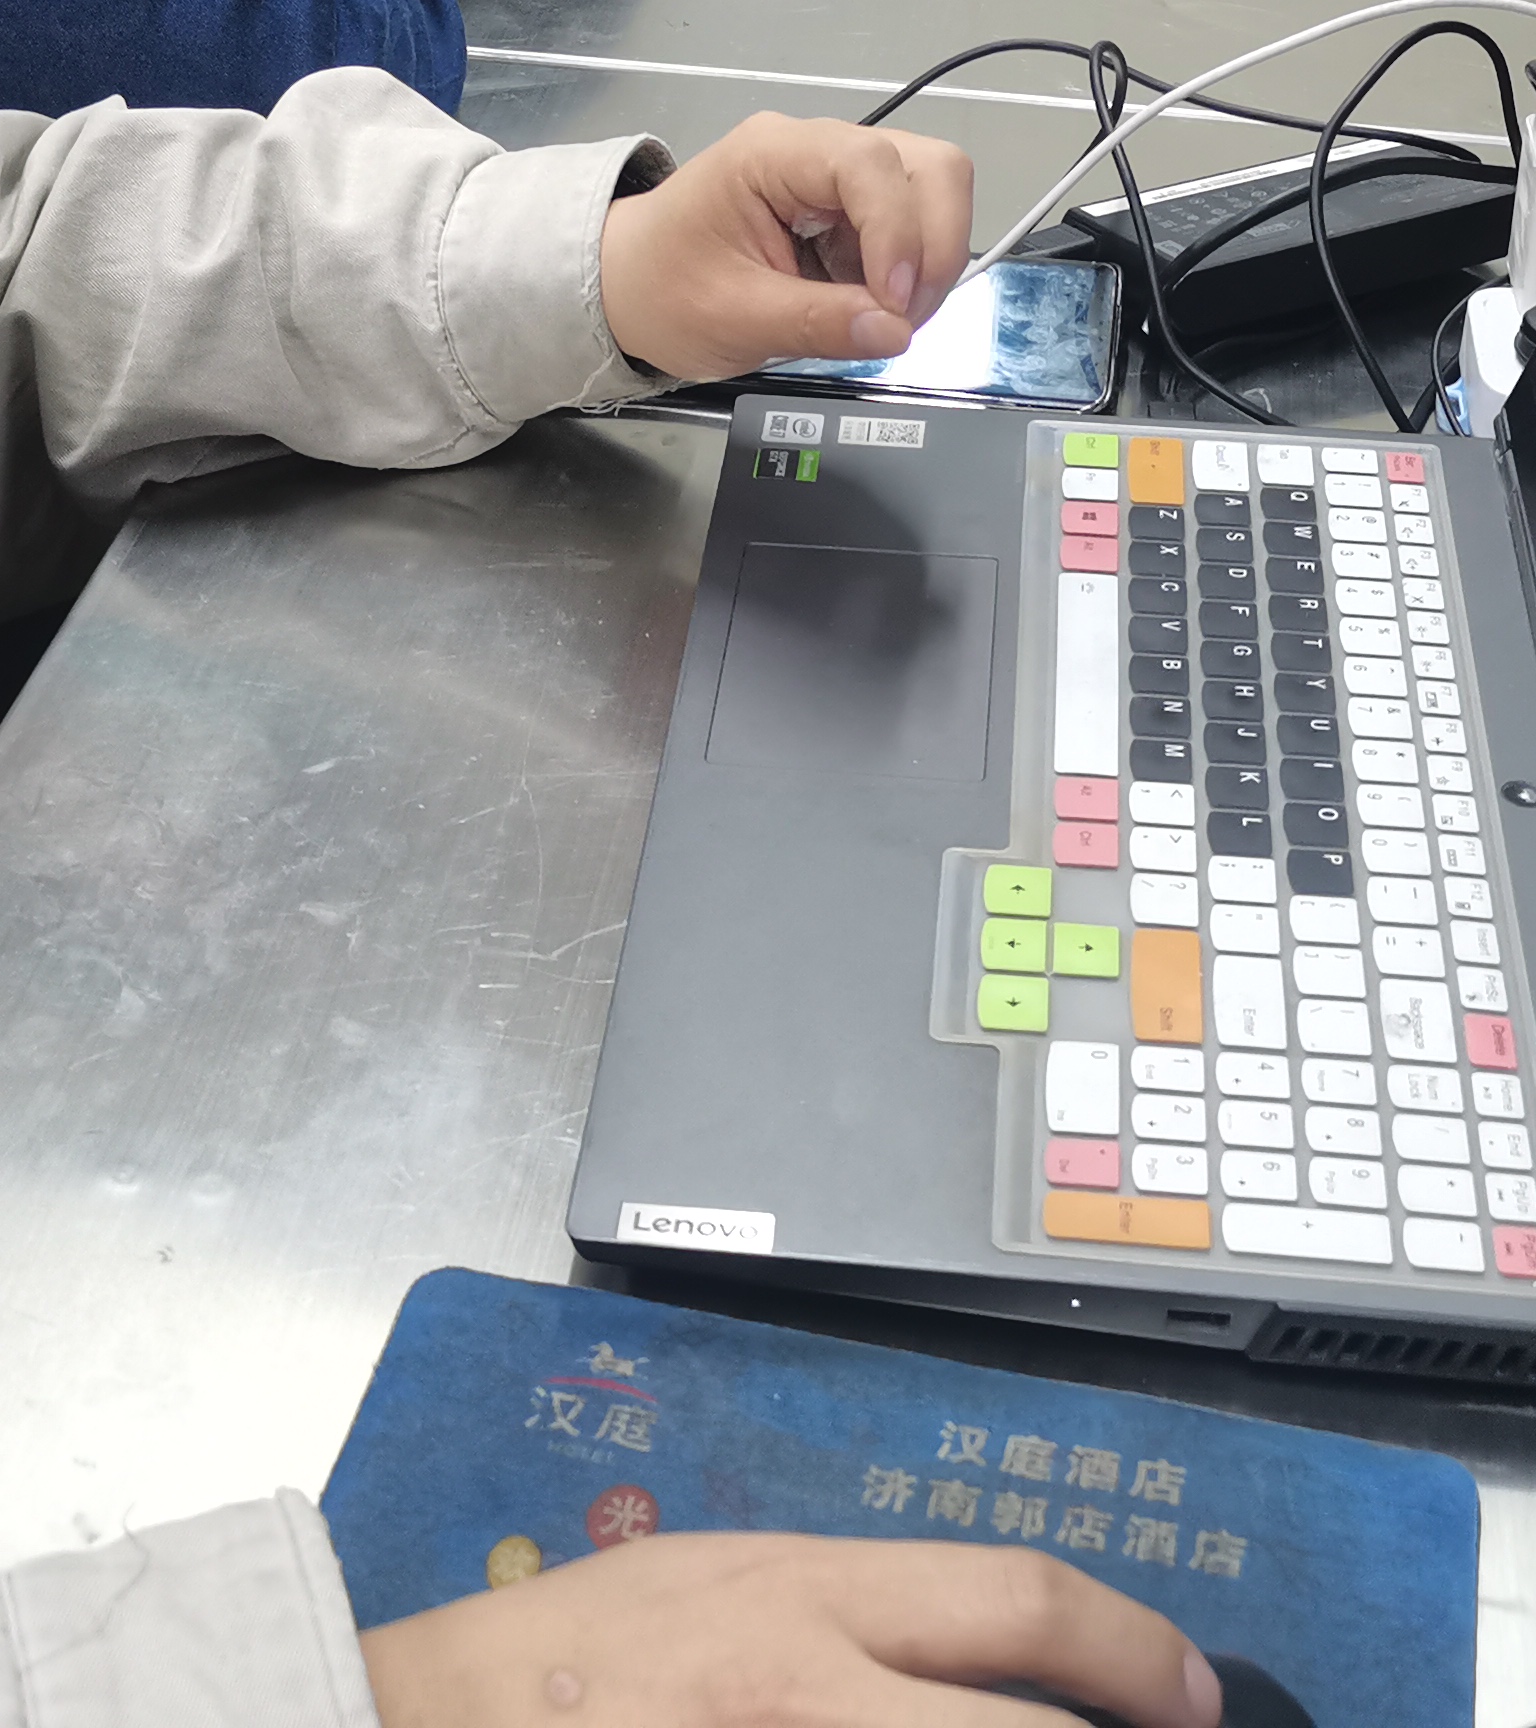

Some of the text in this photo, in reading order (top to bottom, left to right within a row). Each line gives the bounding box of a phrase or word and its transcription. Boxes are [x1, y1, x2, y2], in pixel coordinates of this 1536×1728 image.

[1224, 496, 1243, 507] A
[1290, 491, 1308, 502] Q
[1159, 509, 1178, 520] Z
[1226, 531, 1245, 542] S
[1293, 525, 1313, 539] W
[1160, 545, 1179, 555] X
[1420, 550, 1432, 560] F3
[1228, 567, 1248, 579] D
[1297, 561, 1315, 573] E
[1161, 581, 1180, 592] C
[1299, 598, 1319, 610] R
[1230, 605, 1250, 617] F
[1161, 620, 1182, 632] V
[1303, 638, 1323, 649] T
[1233, 645, 1253, 657] G
[1162, 659, 1182, 670] B
[1305, 678, 1327, 690] Y
[1234, 685, 1255, 697] H
[1162, 700, 1184, 713] N
[1310, 719, 1331, 731] U
[1237, 727, 1258, 737] J
[1164, 743, 1185, 758] M
[1239, 771, 1261, 784] K
[1317, 807, 1339, 821] O
[1242, 817, 1263, 827] L
[1322, 853, 1344, 865] P
[1242, 1008, 1256, 1037] Enter
[1491, 1024, 1505, 1056] Delete
[1501, 1079, 1514, 1112] Home
[1174, 1104, 1192, 1115] 2
[1260, 1111, 1278, 1121] 5
[1346, 1117, 1365, 1128] 8
[1507, 1133, 1521, 1158] End
[1176, 1155, 1194, 1165] 3
[1262, 1161, 1281, 1172] 6
[1351, 1168, 1370, 1179] 9
[633, 1210, 758, 1240] Lenovo
[523, 1384, 659, 1453] 汉庭
[936, 1420, 1187, 1506] 汉庭酒店
[861, 1463, 1249, 1579] 济南郭店酒店
